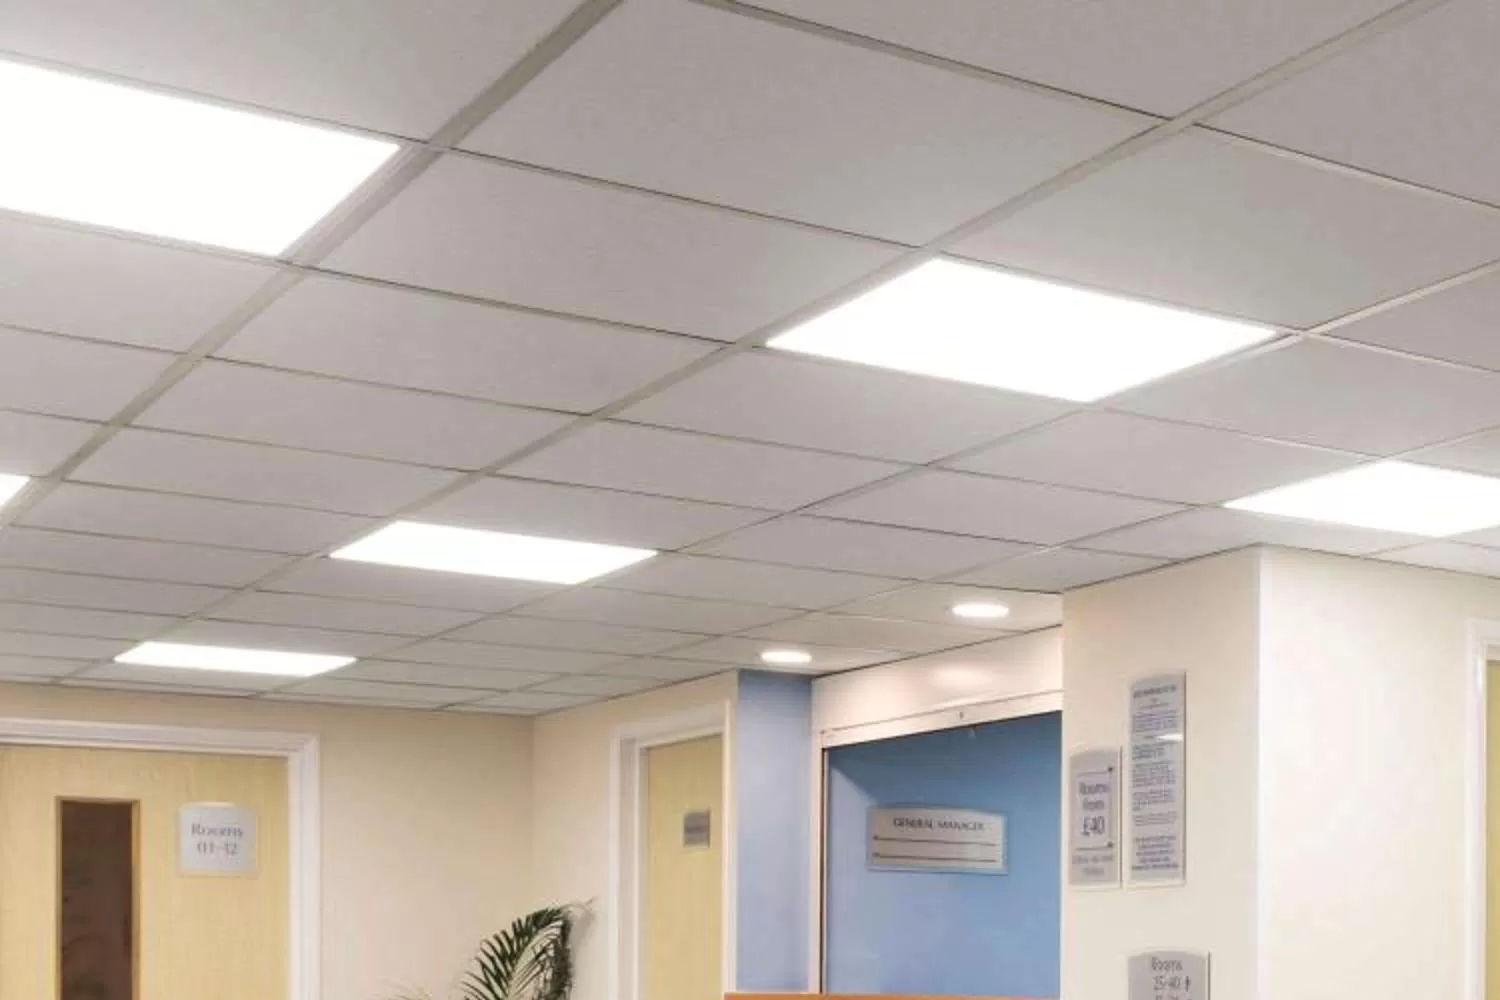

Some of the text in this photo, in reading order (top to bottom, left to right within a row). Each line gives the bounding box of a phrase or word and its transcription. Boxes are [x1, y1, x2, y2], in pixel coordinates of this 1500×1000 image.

[191, 823, 244, 837] Rooms
[1082, 815, 1106, 837] £40
[1150, 956, 1184, 972] Rooms
